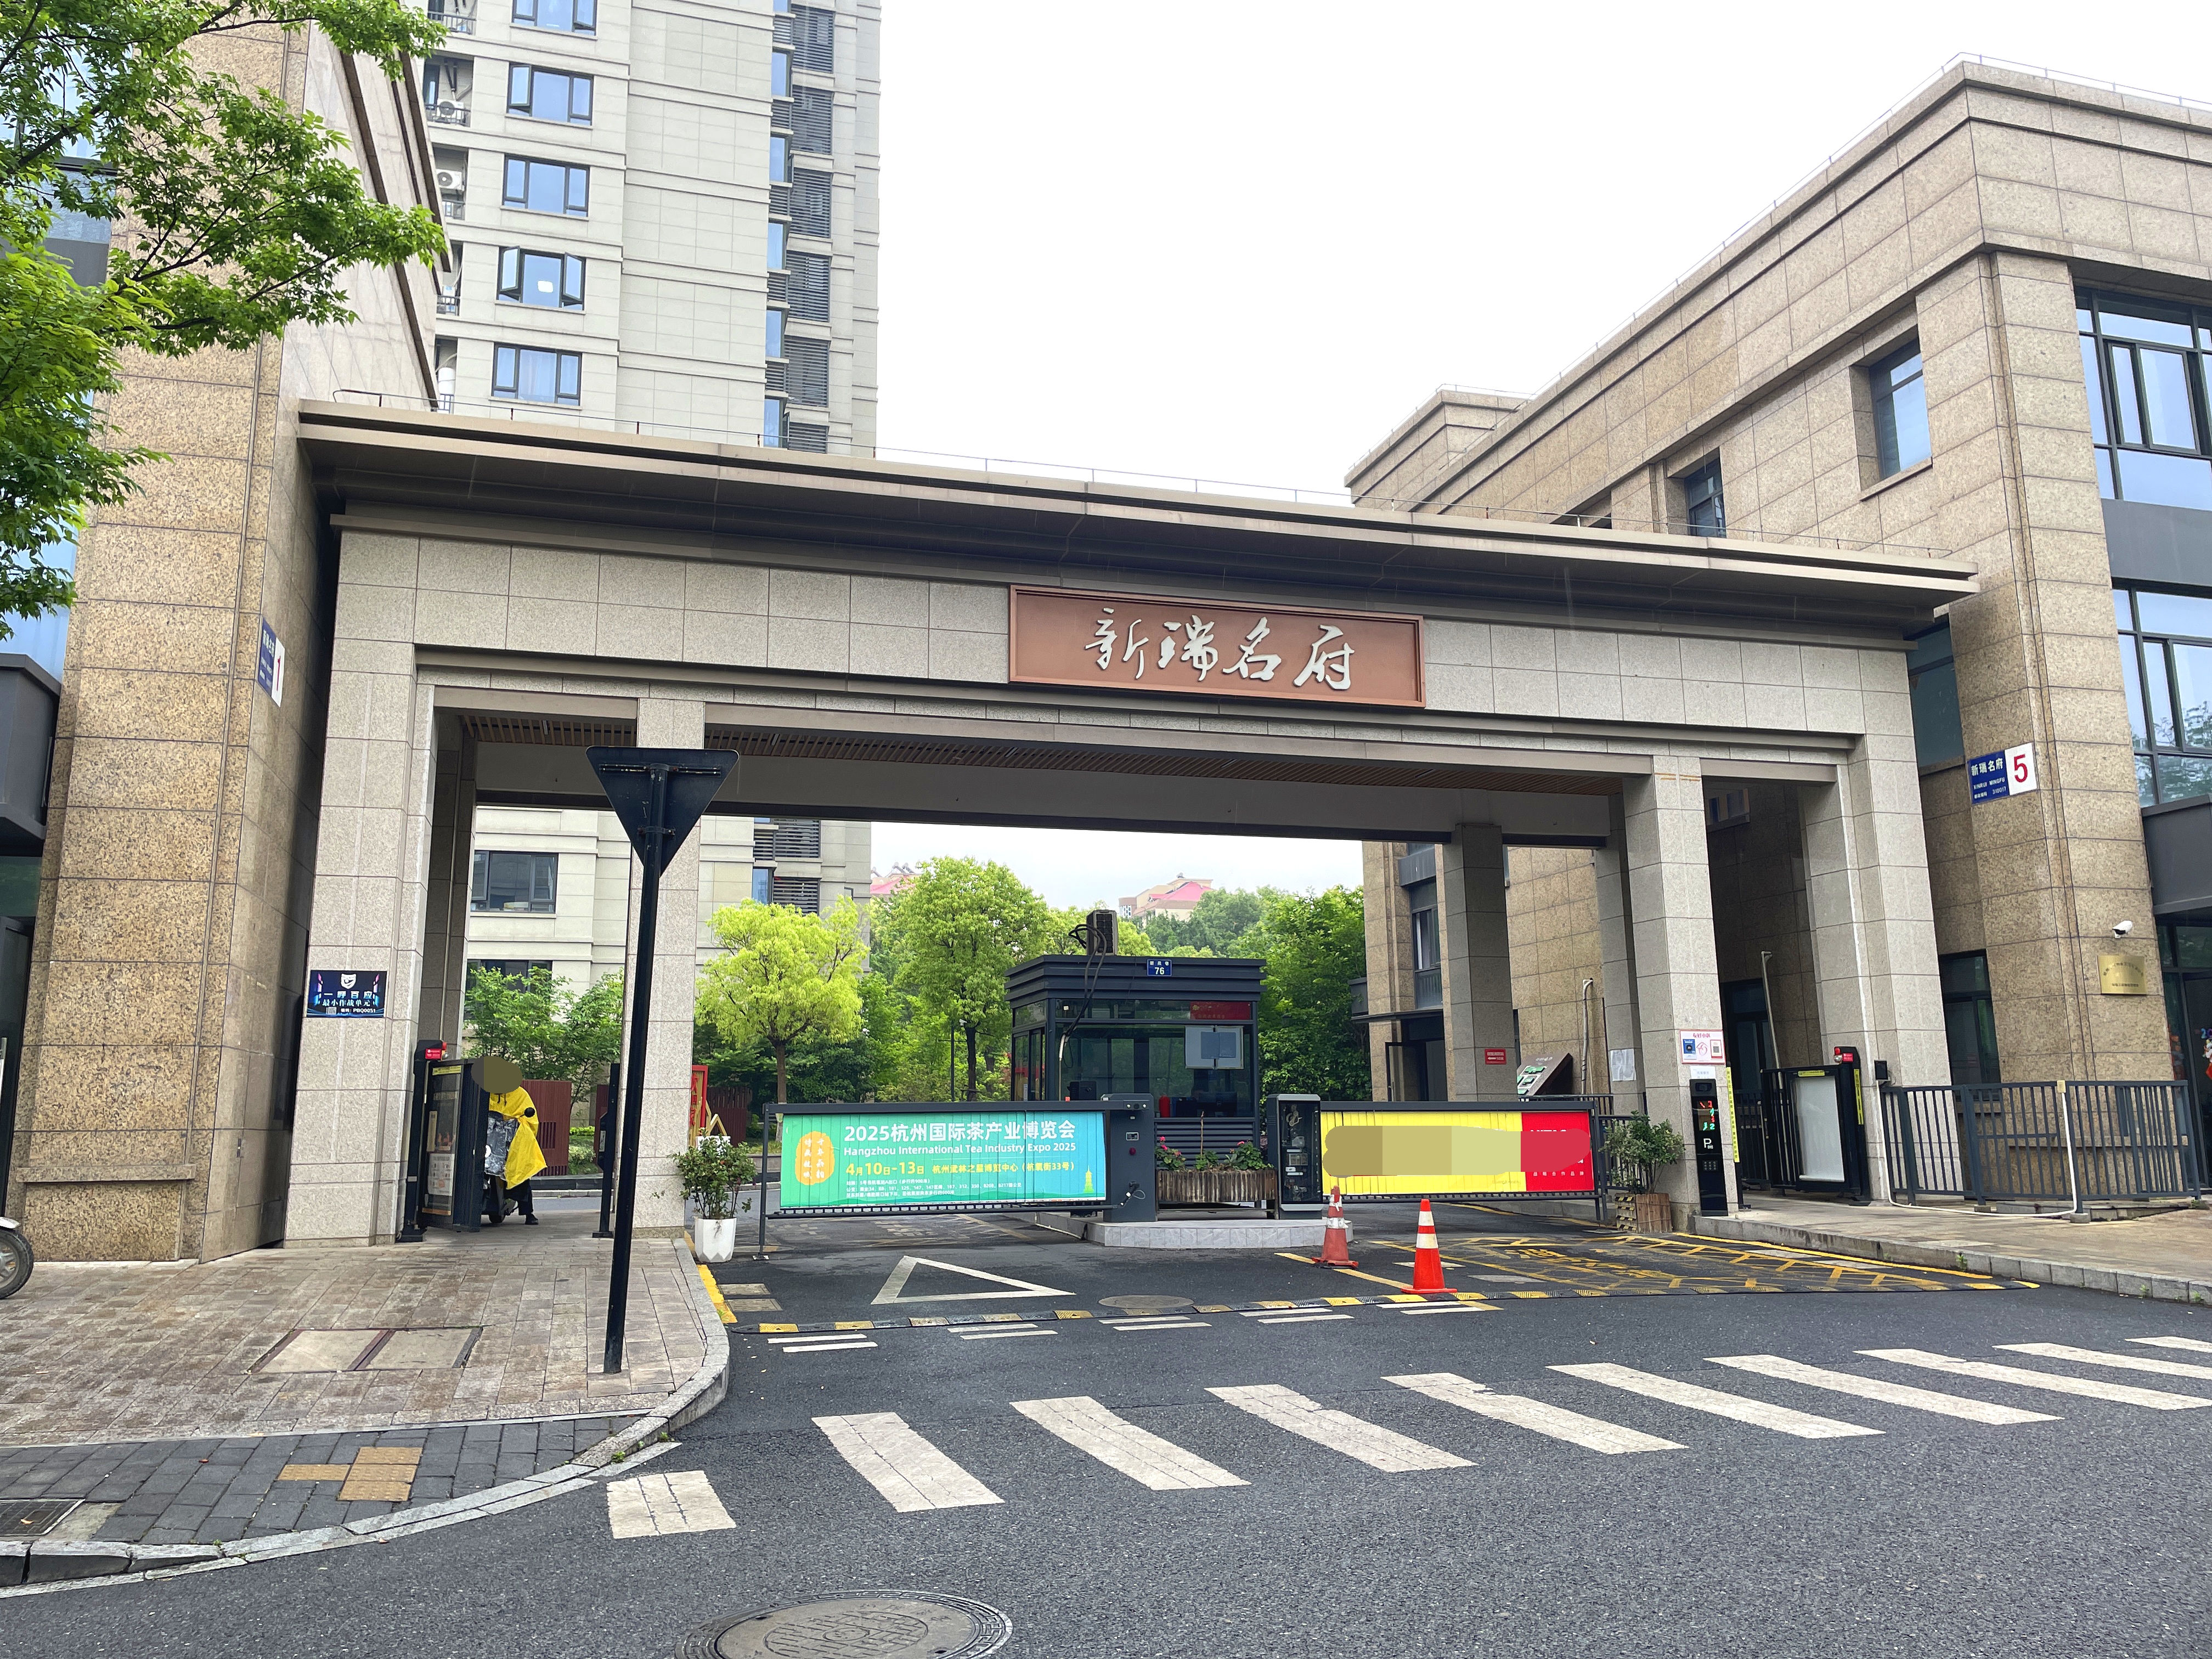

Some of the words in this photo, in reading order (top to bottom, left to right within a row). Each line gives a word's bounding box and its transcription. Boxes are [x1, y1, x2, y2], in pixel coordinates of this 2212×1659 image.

[1085, 607, 1355, 690] 新瑞名府
[1971, 758, 2003, 776] 新瑞名府
[2013, 754, 2028, 783] 5
[1155, 967, 1165, 975] 76
[324, 990, 373, 999] 一呼百应
[322, 998, 371, 1007] 最小作战单元
[844, 1119, 1076, 1143] 2025杭州国际茶产业博览会
[844, 1146, 896, 1158] Hangzhou
[899, 1144, 963, 1154] International
[965, 1144, 983, 1153] Tea
[985, 1143, 1025, 1154] Industry
[1028, 1143, 1051, 1153] Expo
[1053, 1142, 1076, 1152] 2025
[1703, 1138, 1712, 1148] P
[845, 1161, 924, 1176] 4月10日-13日
